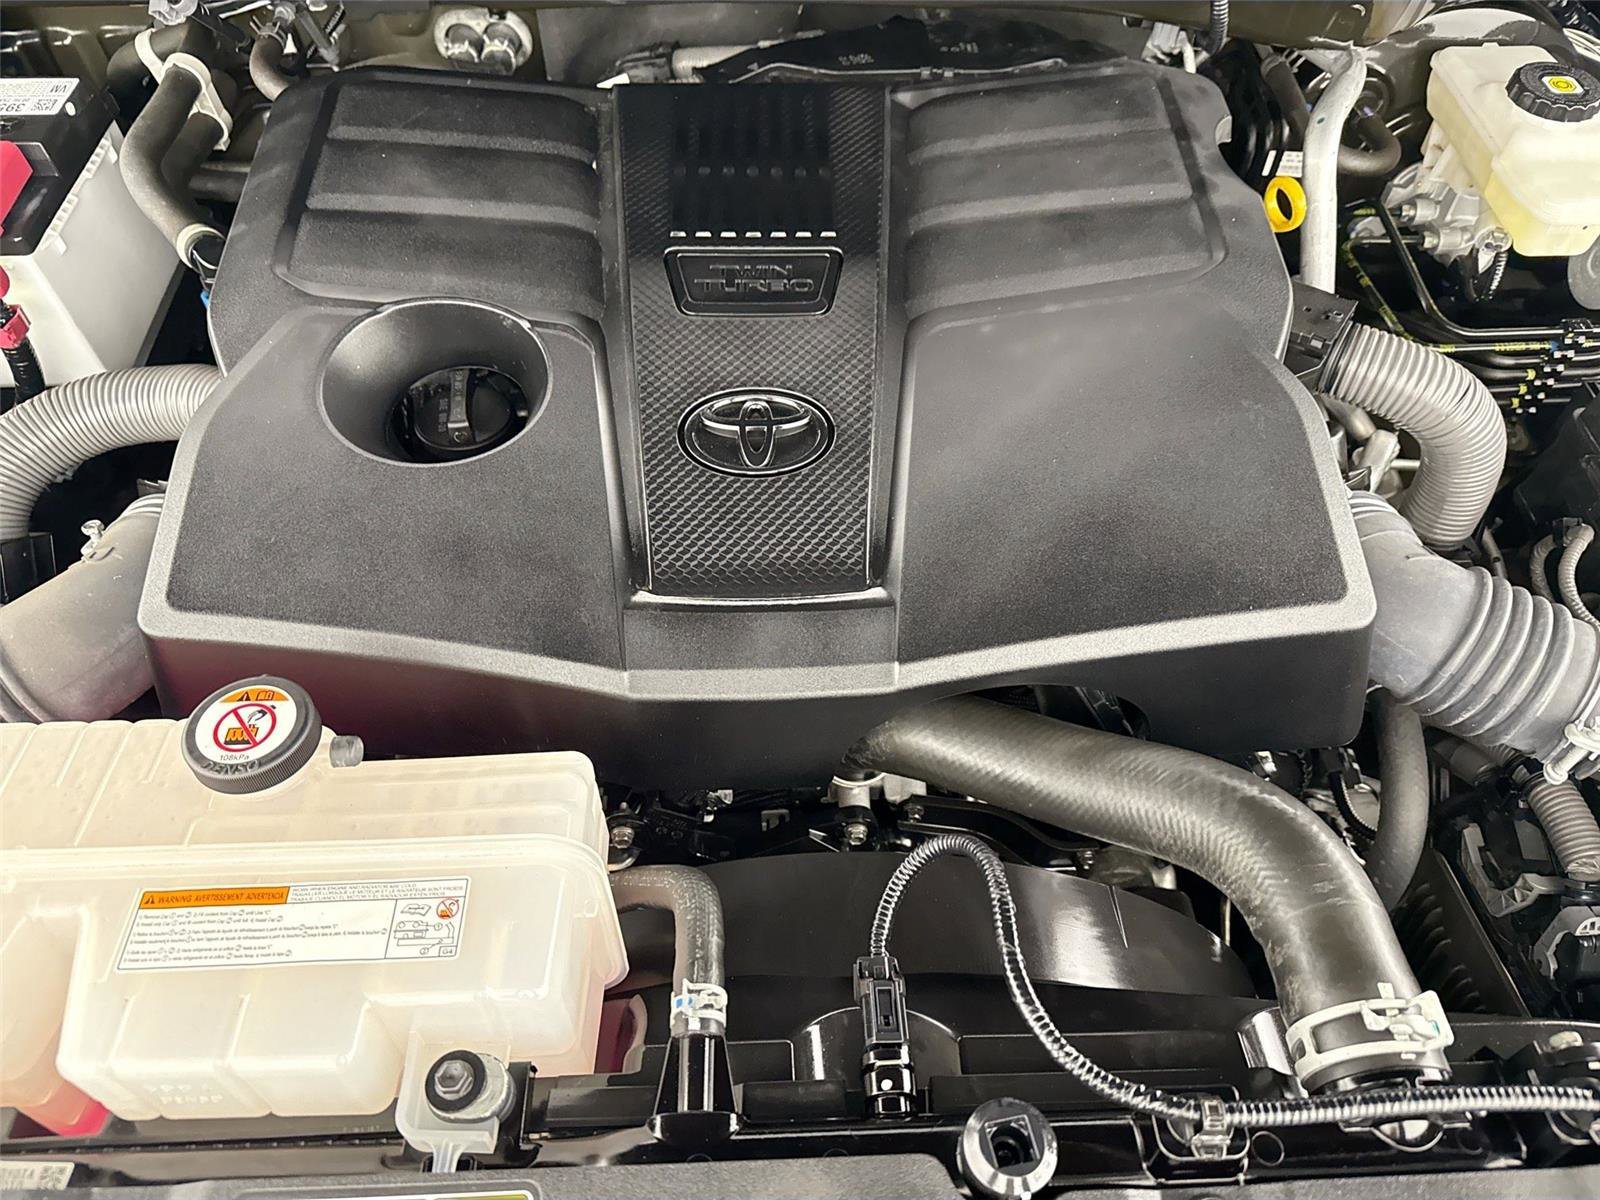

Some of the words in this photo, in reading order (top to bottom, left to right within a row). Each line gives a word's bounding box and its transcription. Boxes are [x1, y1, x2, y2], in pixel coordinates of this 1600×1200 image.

[709, 264, 793, 278] TWIN
[693, 278, 815, 293] TURBO
[219, 752, 250, 761] 108kPa
[201, 759, 259, 775] DENSO
[157, 894, 193, 904] WARNING
[193, 892, 244, 902] AVERTISSEMENT
